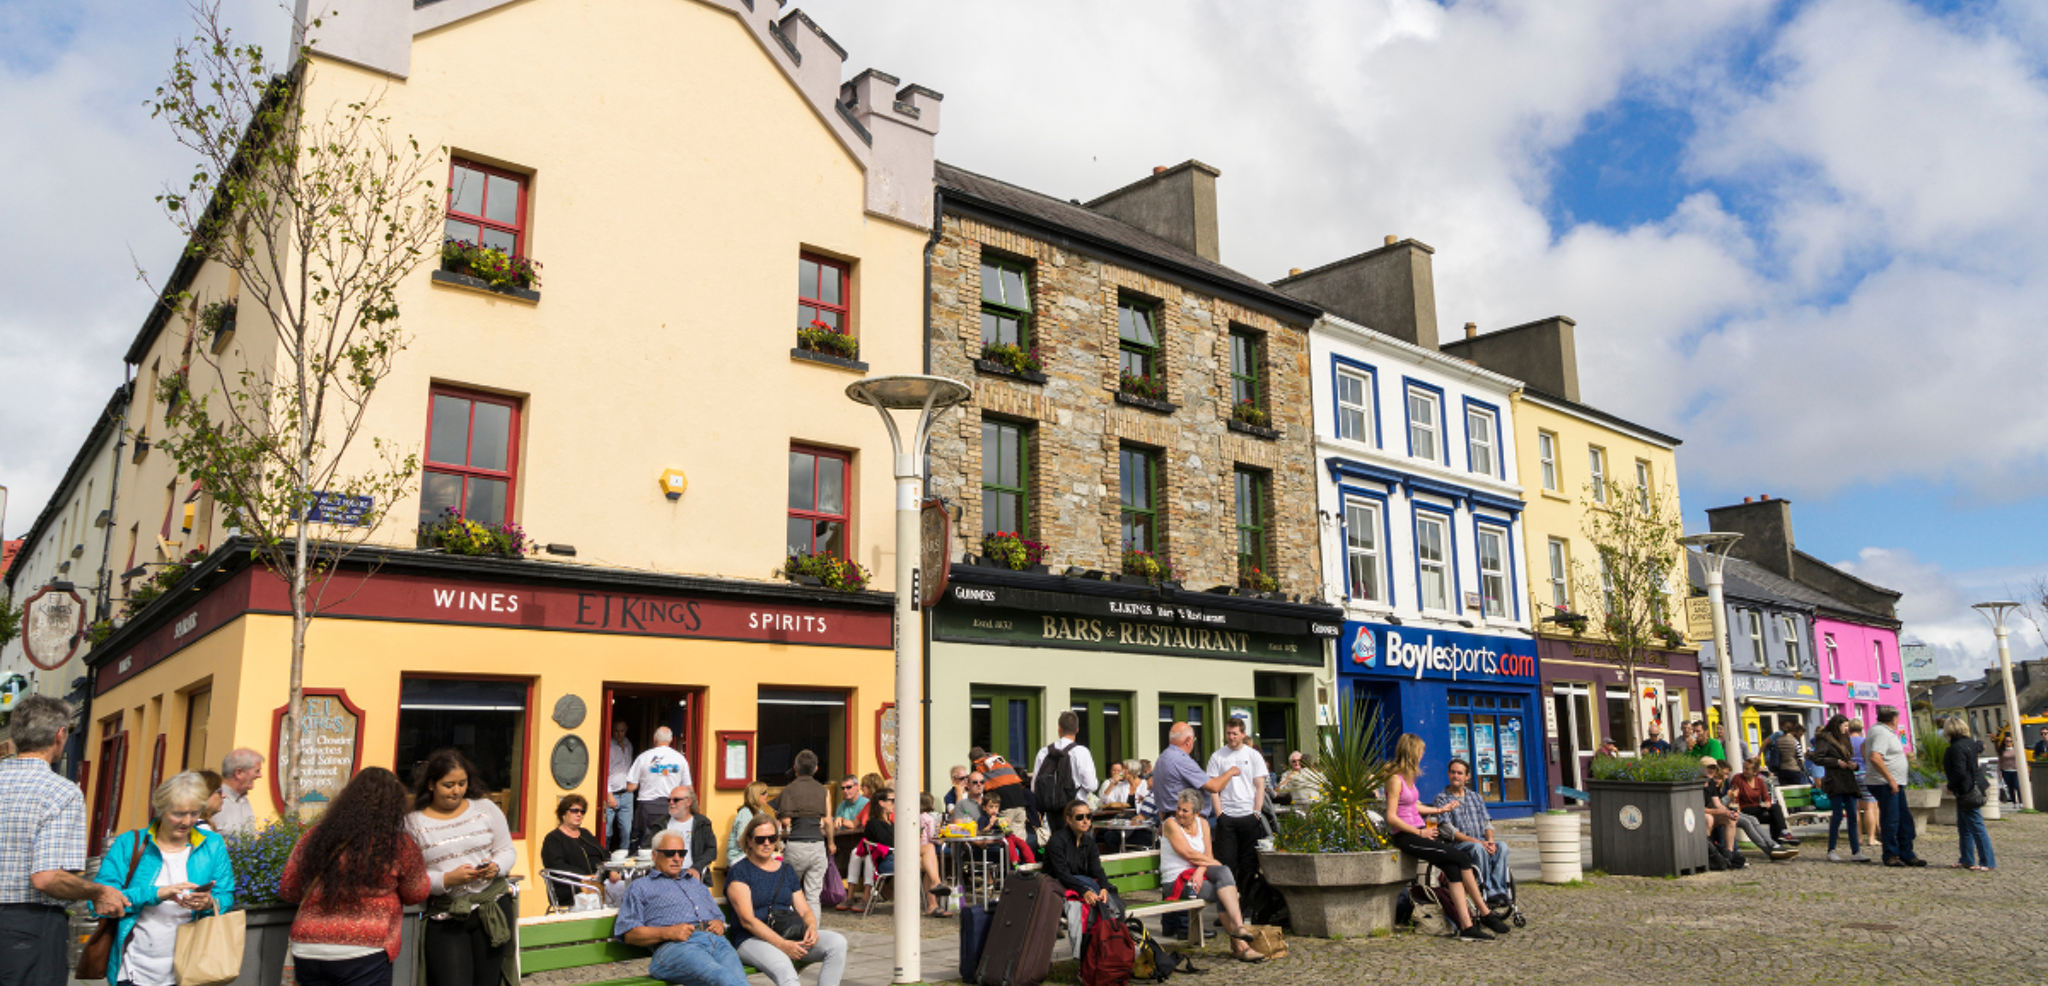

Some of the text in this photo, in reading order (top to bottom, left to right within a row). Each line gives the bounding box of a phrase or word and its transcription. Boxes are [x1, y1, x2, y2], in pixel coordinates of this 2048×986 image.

[955, 586, 995, 601] GUINNESS
[433, 588, 518, 612] WINES
[749, 612, 827, 633] SPIRITS
[1041, 615, 1102, 643] BARS
[1105, 626, 1115, 638] &
[1119, 622, 1250, 653] RESTAURANT
[1385, 630, 1535, 681] Boylesports.com
[317, 755, 351, 765] Salmon
[300, 777, 332, 789] ysters
